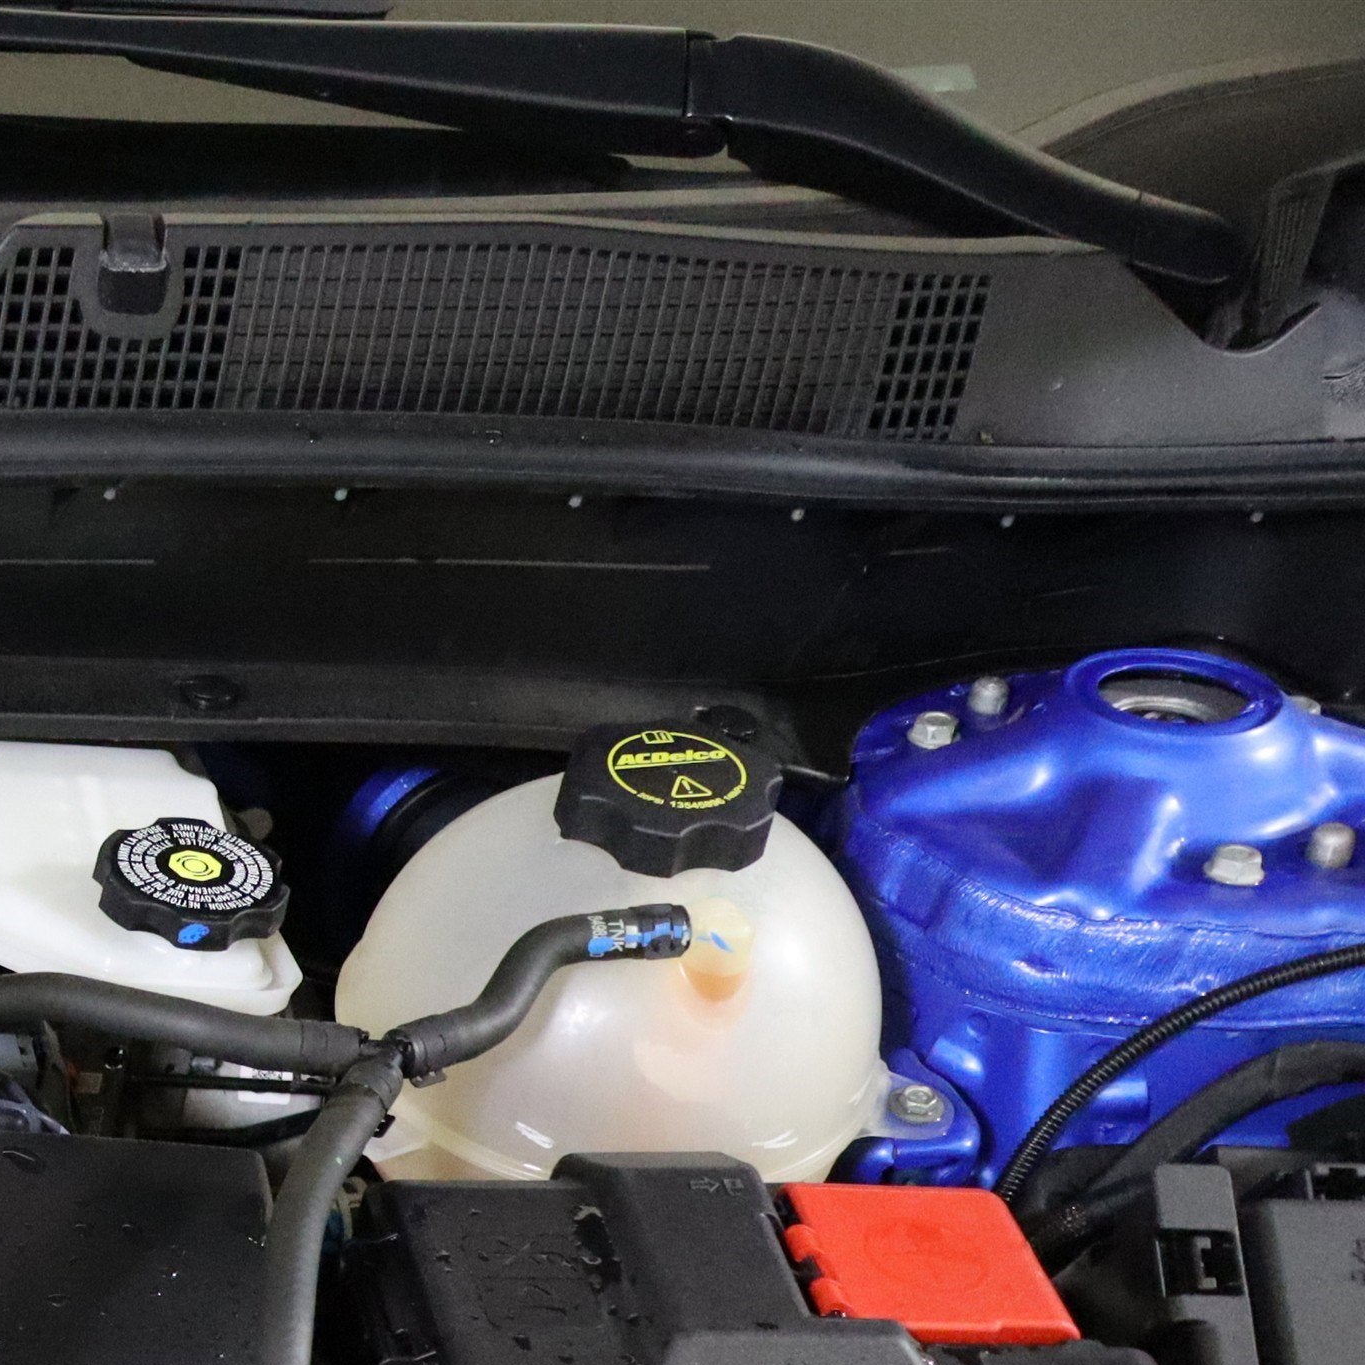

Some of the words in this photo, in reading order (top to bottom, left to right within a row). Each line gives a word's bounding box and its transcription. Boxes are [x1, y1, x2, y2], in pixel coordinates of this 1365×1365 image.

[616, 750, 727, 766] ACDelco
[169, 830, 194, 838] ONLY
[198, 832, 216, 842] USE
[177, 838, 211, 848] FILLER
[165, 887, 184, 898] QUE
[176, 882, 232, 894] PROVENANT
[152, 890, 199, 910] NETTOYER
[607, 918, 625, 952] TNK
